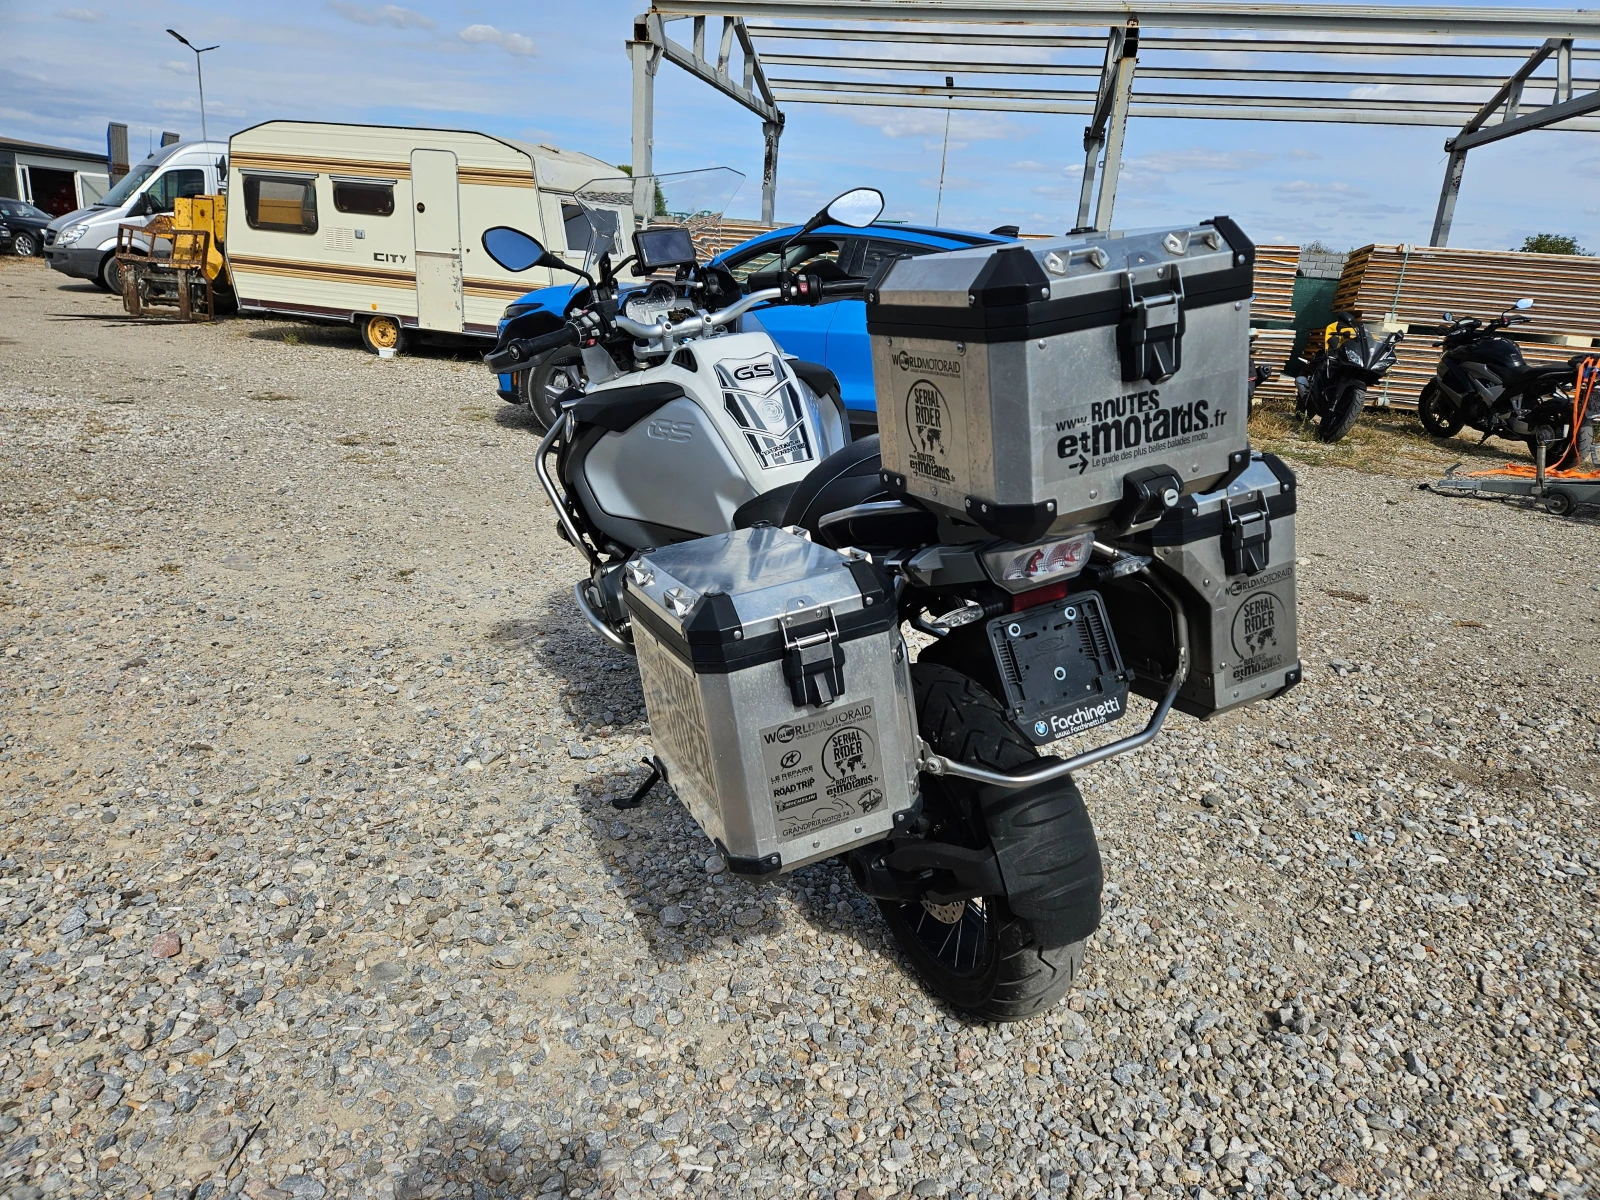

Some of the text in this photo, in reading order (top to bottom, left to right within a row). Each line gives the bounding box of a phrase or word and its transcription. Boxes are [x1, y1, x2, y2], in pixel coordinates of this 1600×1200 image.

[373, 252, 407, 264] CITY
[733, 363, 775, 381] GS
[891, 350, 961, 374] WORLDMOTORAID
[914, 388, 941, 408] SERIAL
[915, 405, 942, 428] RIDER
[647, 418, 695, 443] GS
[1092, 432, 1209, 468] Le guide des plus belles balades moto
[1243, 596, 1275, 618] SERIAL
[1244, 610, 1275, 635] RIDER
[764, 705, 872, 744] WORLDMOTORAID
[1051, 697, 1121, 732] Facchinetti
[832, 730, 863, 748] SERIAL
[833, 741, 863, 761] RIDER
[821, 812, 842, 824] MOTOS
